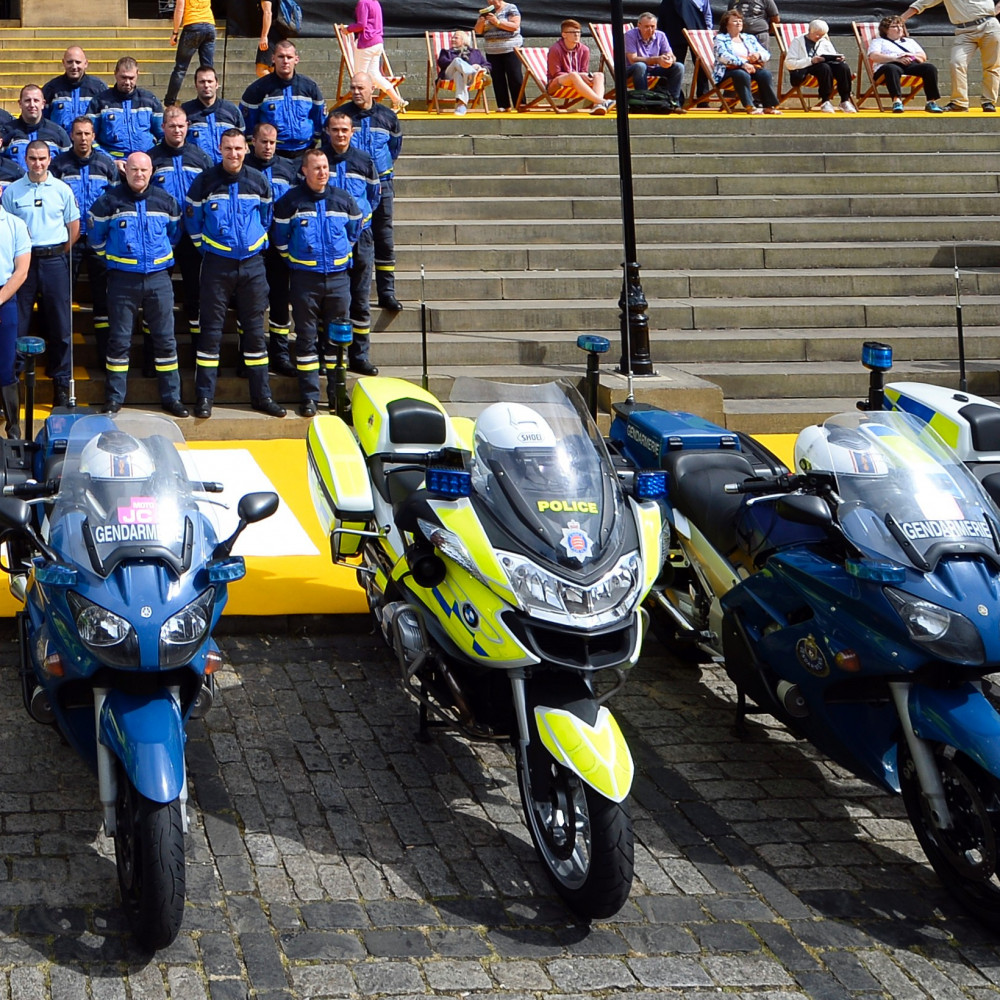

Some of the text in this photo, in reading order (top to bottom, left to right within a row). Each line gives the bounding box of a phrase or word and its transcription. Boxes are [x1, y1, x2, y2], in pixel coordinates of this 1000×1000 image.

[537, 500, 599, 514] POLICE
[123, 509, 152, 523] JC
[902, 520, 993, 540] GENDARMERIE
